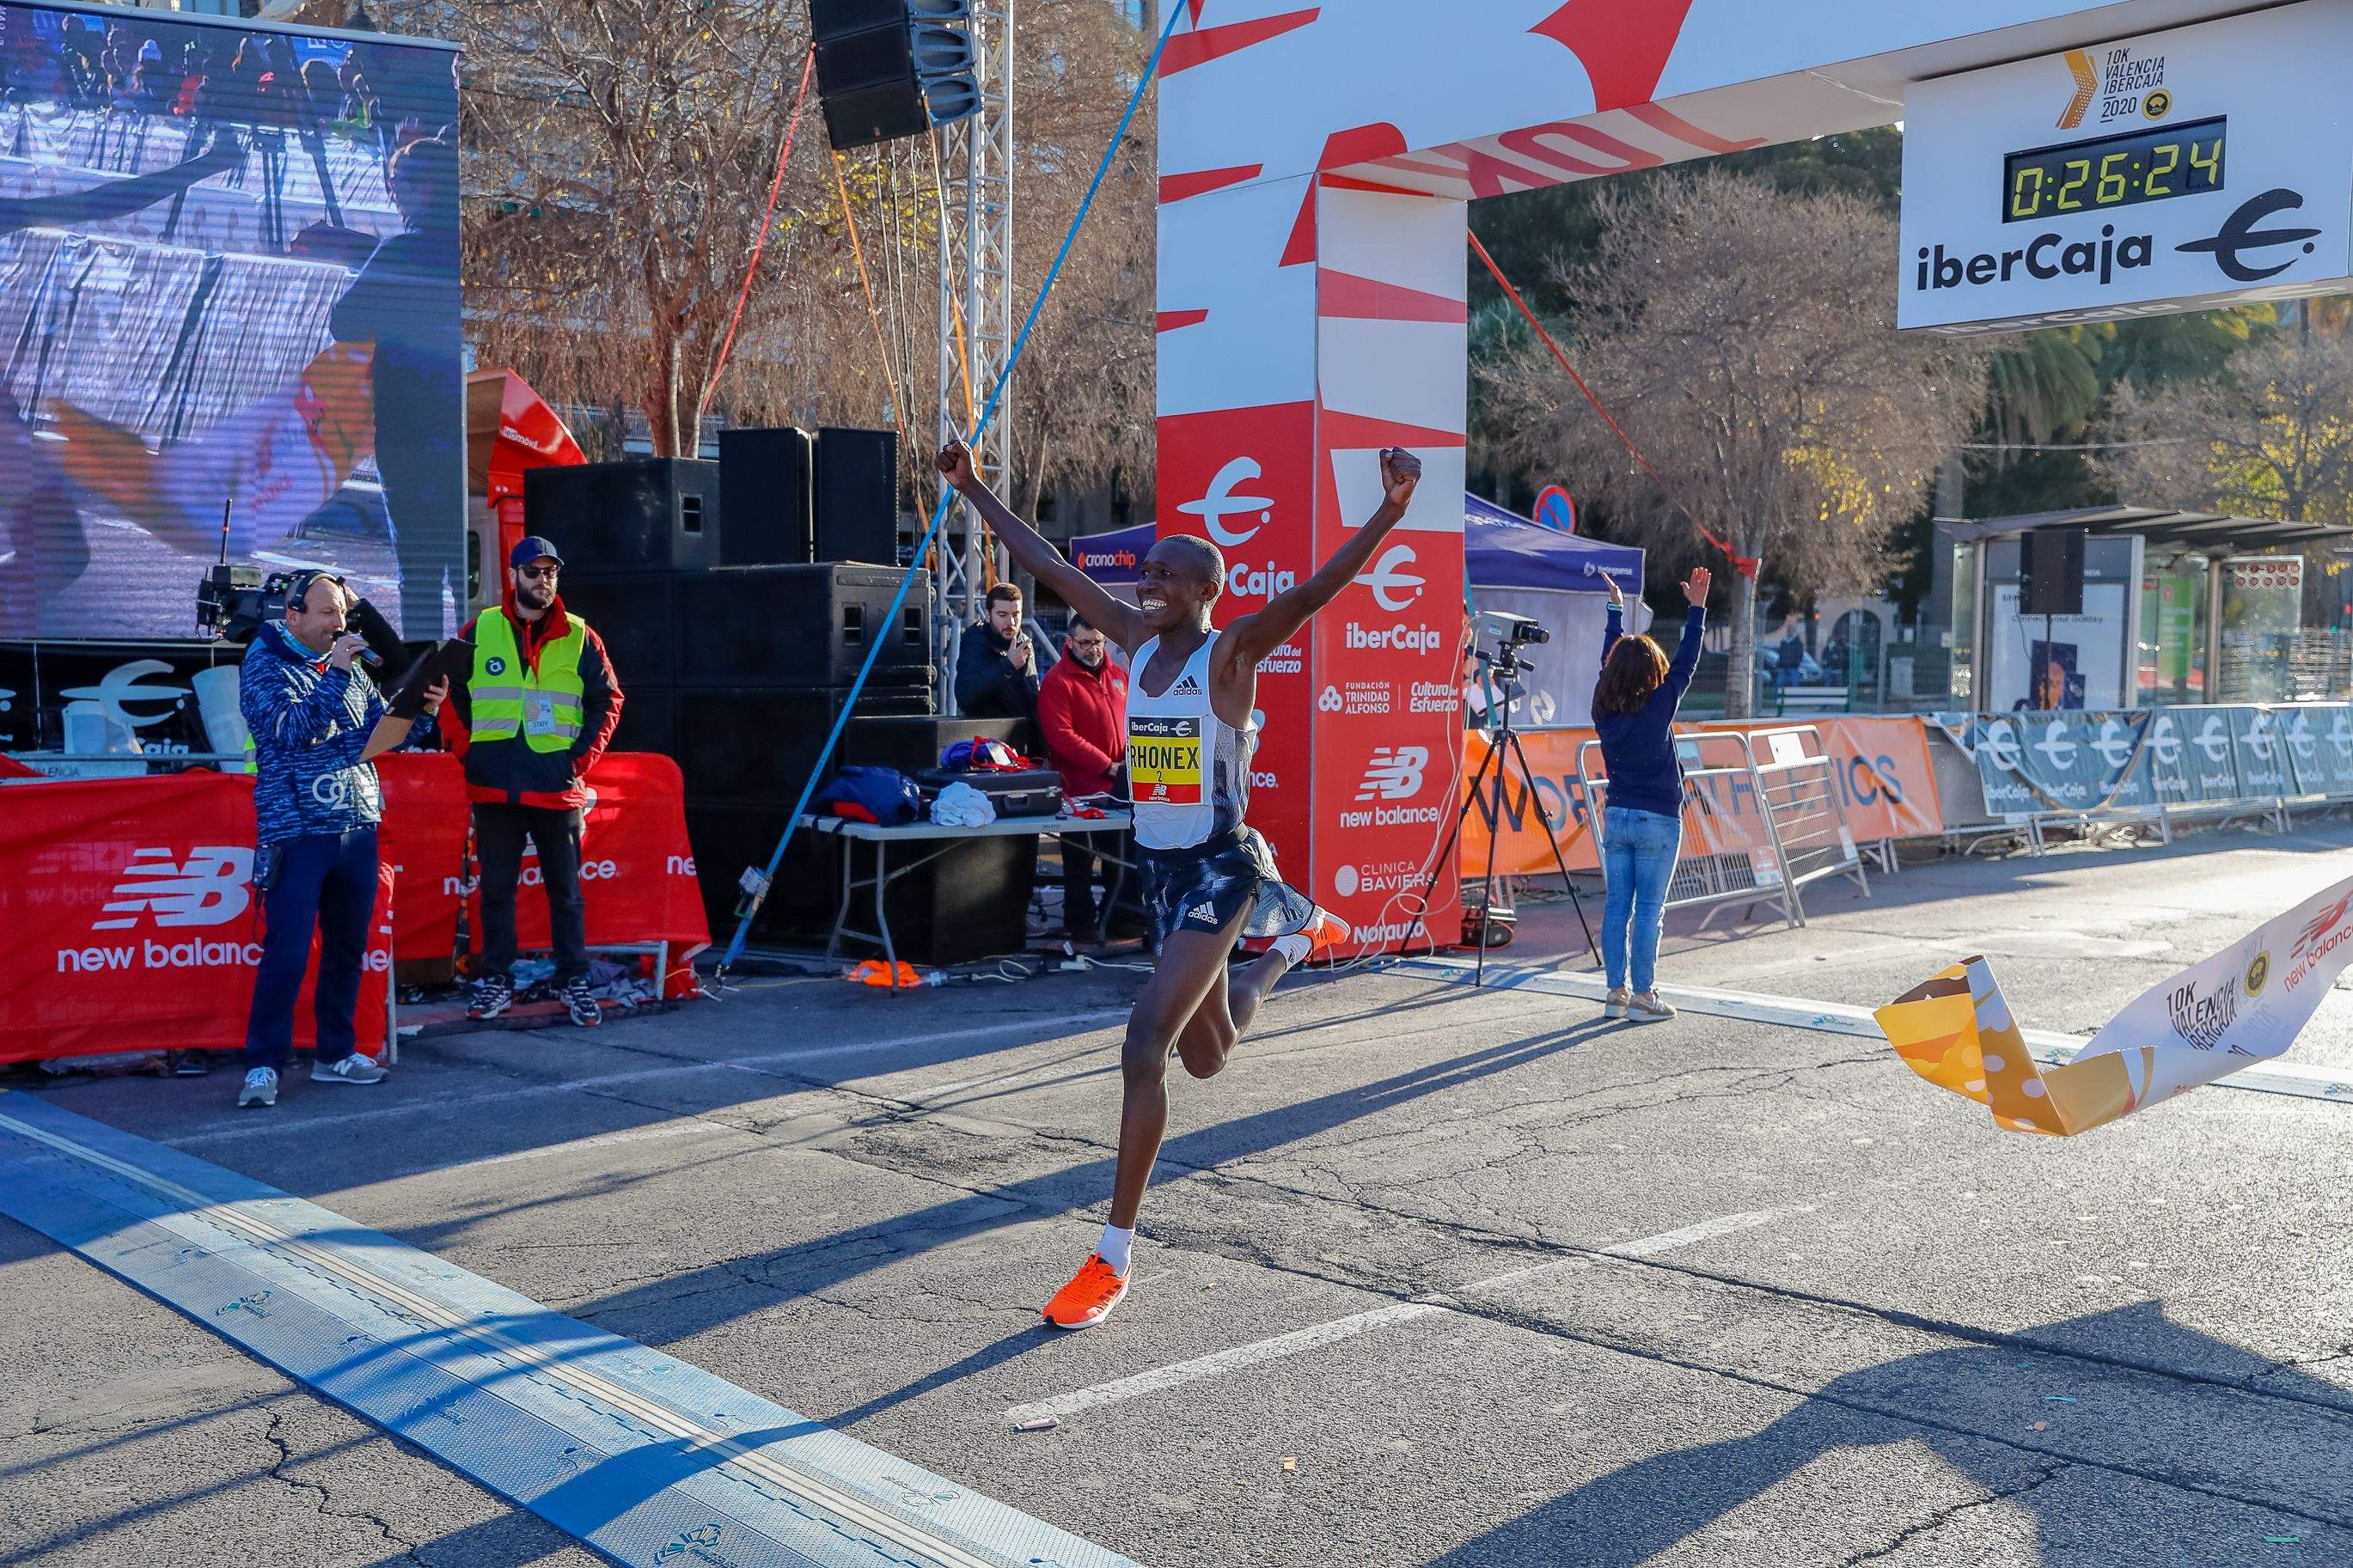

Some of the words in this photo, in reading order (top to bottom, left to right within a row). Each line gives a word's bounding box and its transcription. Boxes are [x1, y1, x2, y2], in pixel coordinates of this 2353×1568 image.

[2107, 48, 2130, 65] 10K
[2105, 57, 2165, 80] VALENCIA
[2104, 71, 2163, 95] IBERCAJA
[2101, 97, 2137, 118] 2020
[2012, 139, 2222, 217] 0:26:24
[1917, 224, 2153, 290] iberCaja
[1085, 551, 1136, 569] cronochip
[1346, 622, 1439, 656] iberCaja
[1256, 656, 1302, 673] sfuerzo
[1173, 687, 1203, 696] adidas
[1345, 692, 1390, 703] TRINIDAD
[1411, 681, 1450, 696] Cultura
[1345, 704, 1390, 714] ALFONSO
[1409, 697, 1458, 712] Esfuerzo
[1131, 722, 1169, 734] iberCaja
[1131, 746, 1200, 770] RHONEX
[1157, 771, 1163, 782] 2
[1340, 810, 1372, 827] new
[1376, 806, 1439, 826] balance
[1360, 861, 1415, 875] CLINICA
[1188, 910, 1219, 924] adidas
[58, 946, 135, 973] new
[144, 937, 264, 968] balanc
[2283, 960, 2307, 992] new
[2307, 925, 2353, 969] balanc
[2167, 980, 2197, 1017] 10K
[2172, 977, 2236, 1039] VALENCIA
[2187, 998, 2237, 1052] IBERCAJA
